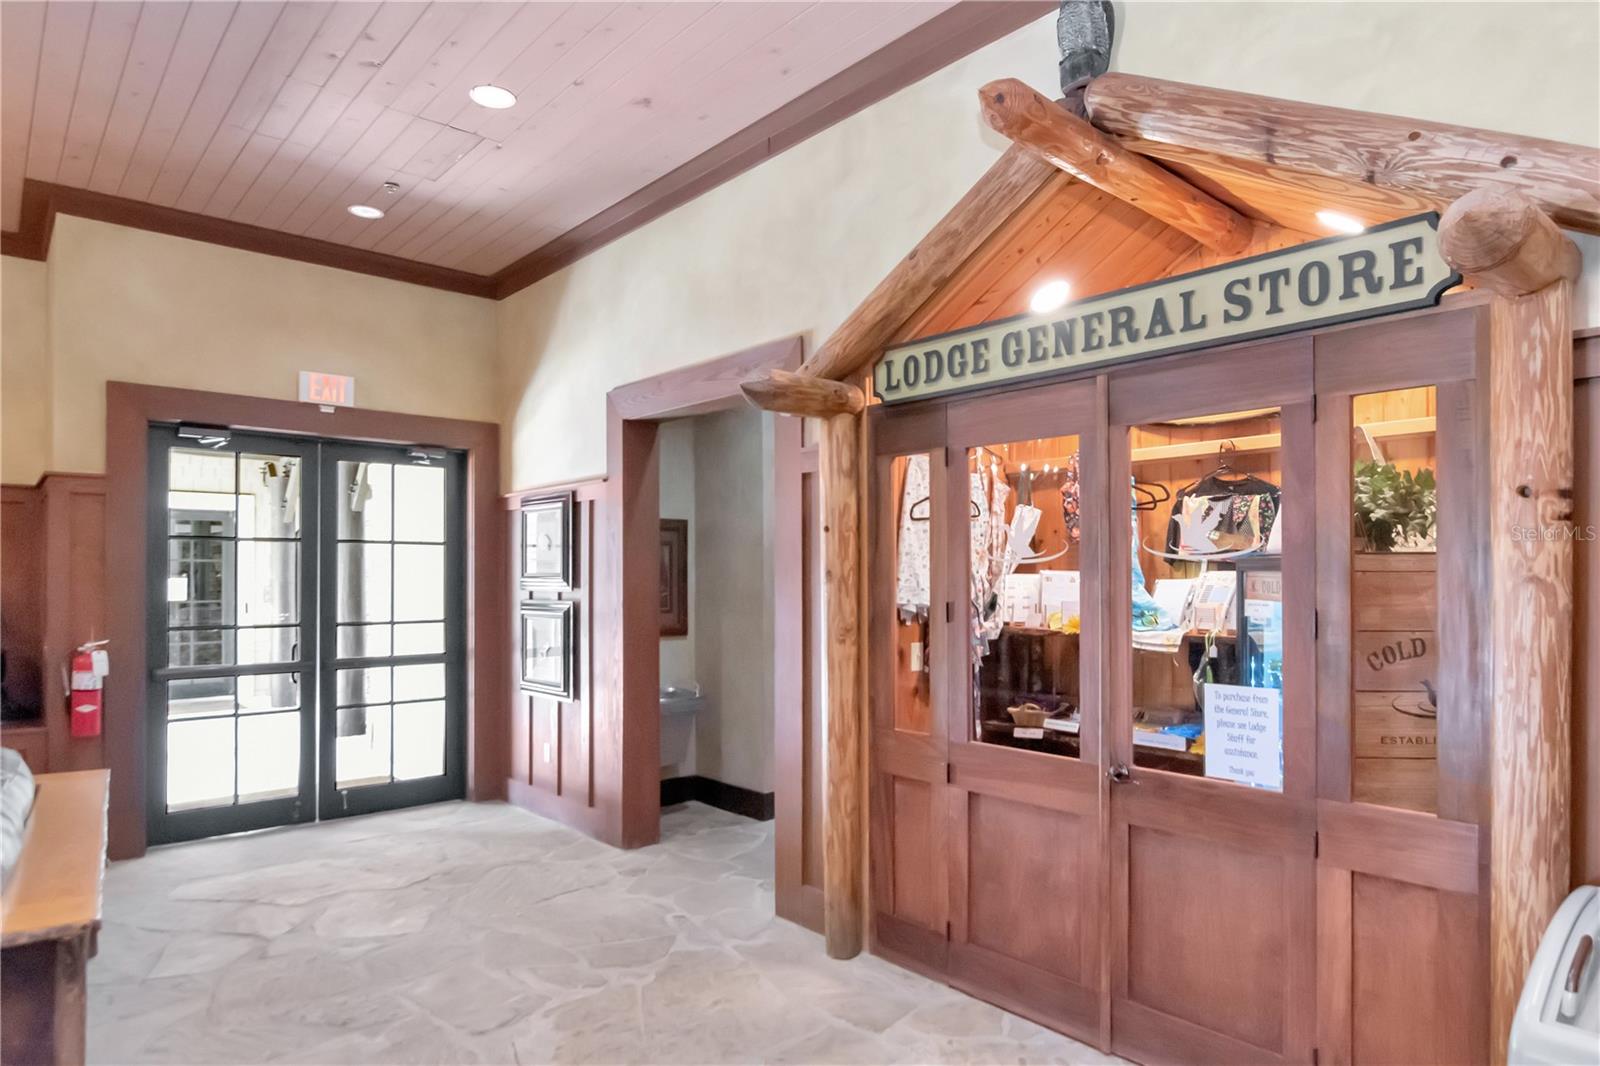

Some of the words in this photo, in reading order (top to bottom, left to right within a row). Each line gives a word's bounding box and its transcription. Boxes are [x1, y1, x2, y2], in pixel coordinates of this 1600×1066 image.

[885, 338, 990, 392] LODGE
[1001, 290, 1207, 367] GENERAL
[1223, 237, 1425, 324] STORE
[310, 373, 347, 403] EXIT
[1367, 637, 1426, 671] COLD
